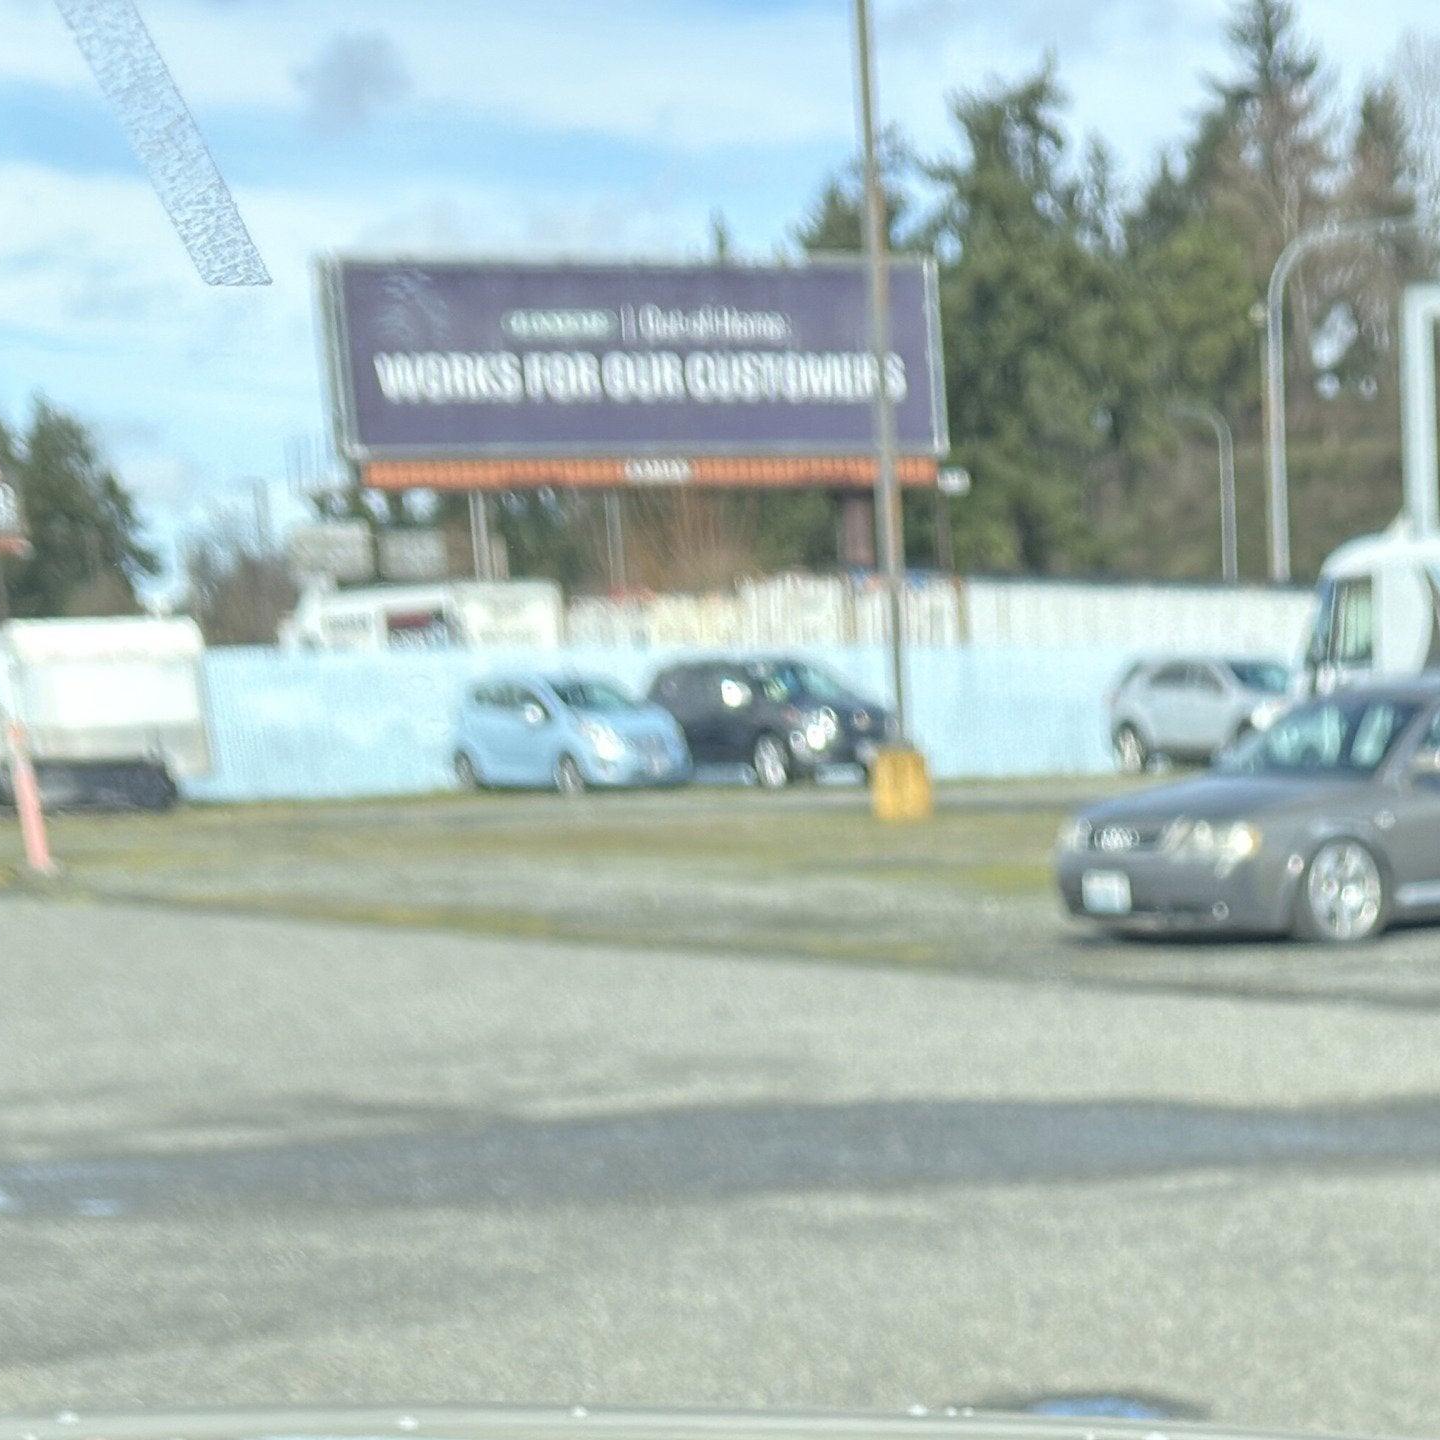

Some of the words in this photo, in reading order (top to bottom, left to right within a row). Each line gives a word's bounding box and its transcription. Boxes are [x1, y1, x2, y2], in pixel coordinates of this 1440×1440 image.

[373, 350, 522, 402] WORKS
[523, 350, 601, 402] FOR
[602, 350, 684, 402] OUR
